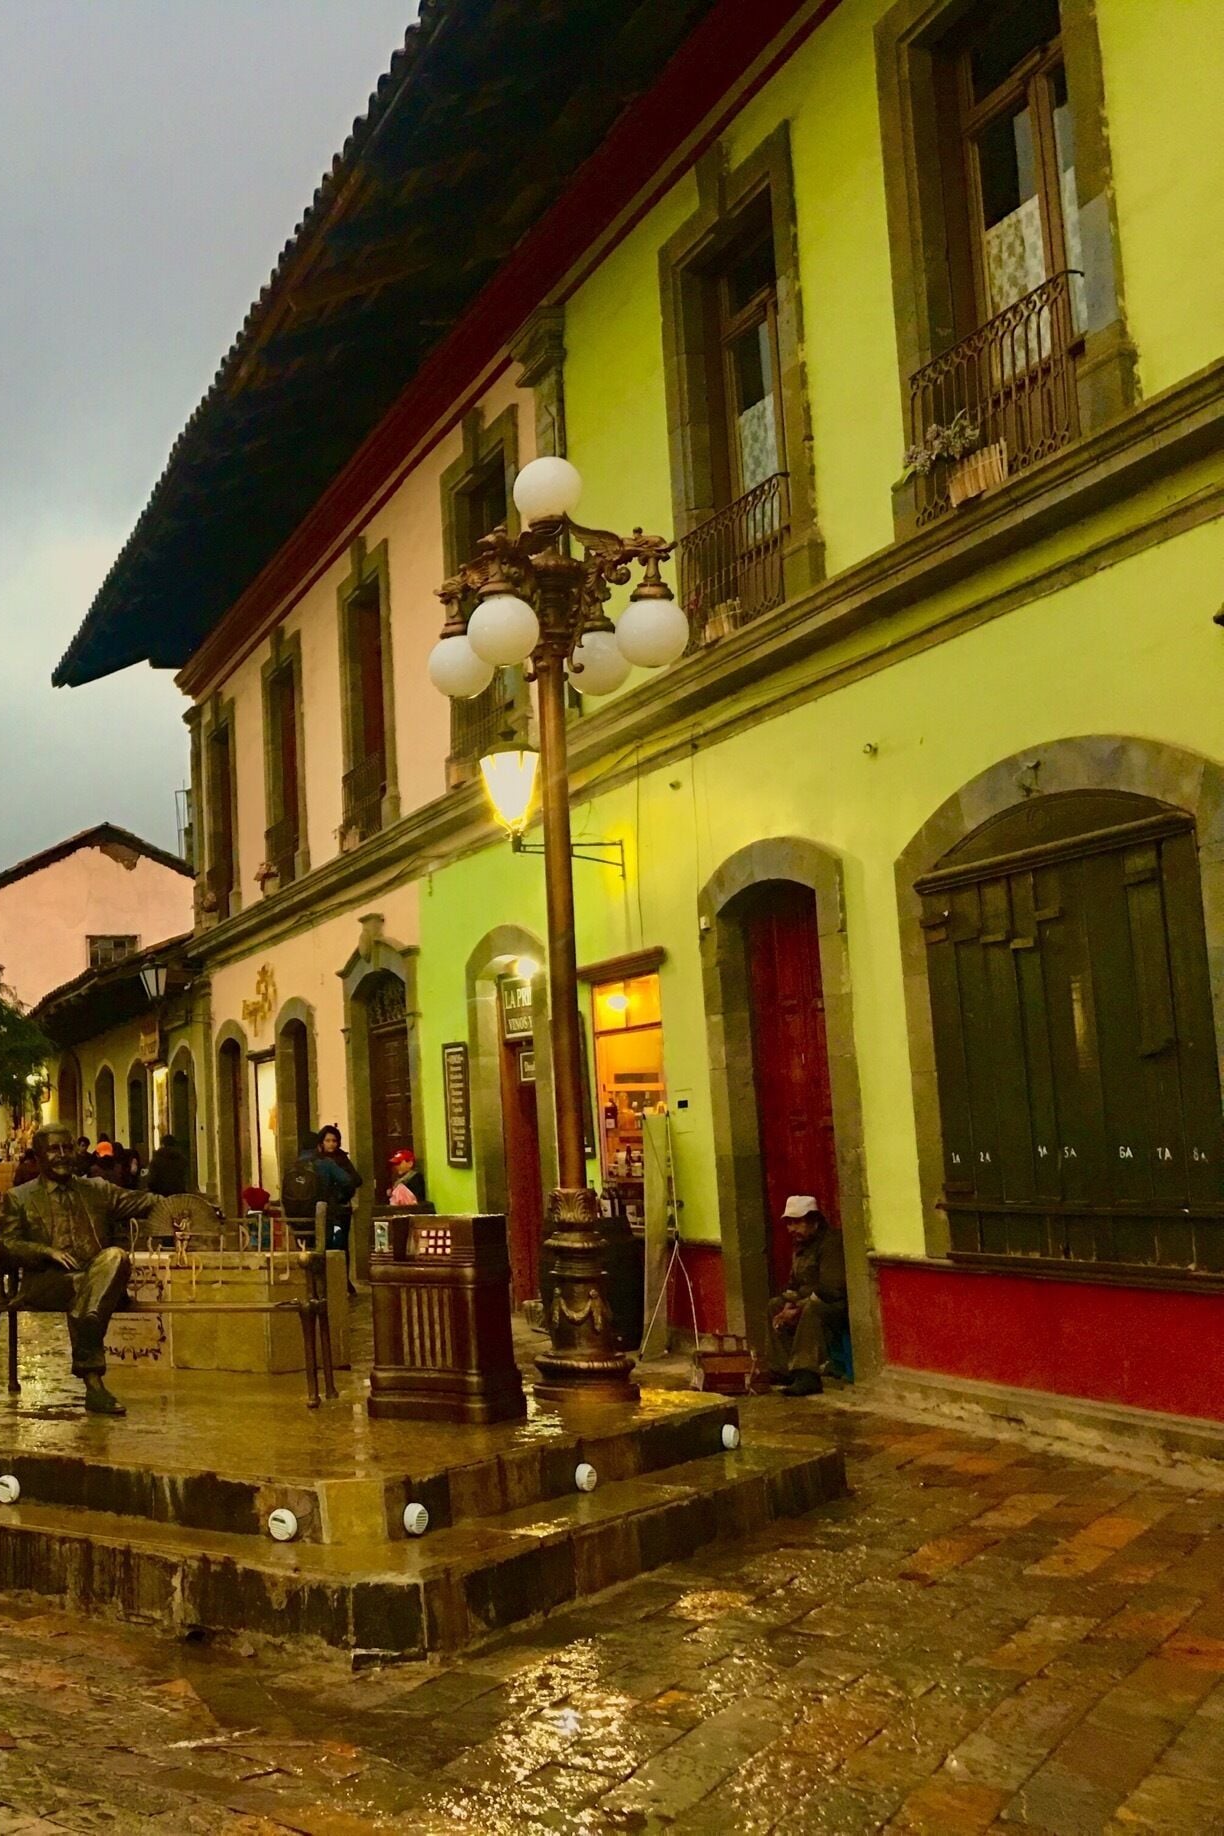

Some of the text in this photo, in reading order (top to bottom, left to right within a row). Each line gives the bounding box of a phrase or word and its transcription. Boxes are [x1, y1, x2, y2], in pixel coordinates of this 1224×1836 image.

[504, 989, 516, 1009] LA
[980, 1151, 991, 1162] 2A
[1064, 1146, 1077, 1158] 5A
[1119, 1146, 1133, 1159] 6A
[1157, 1147, 1172, 1160] 7A
